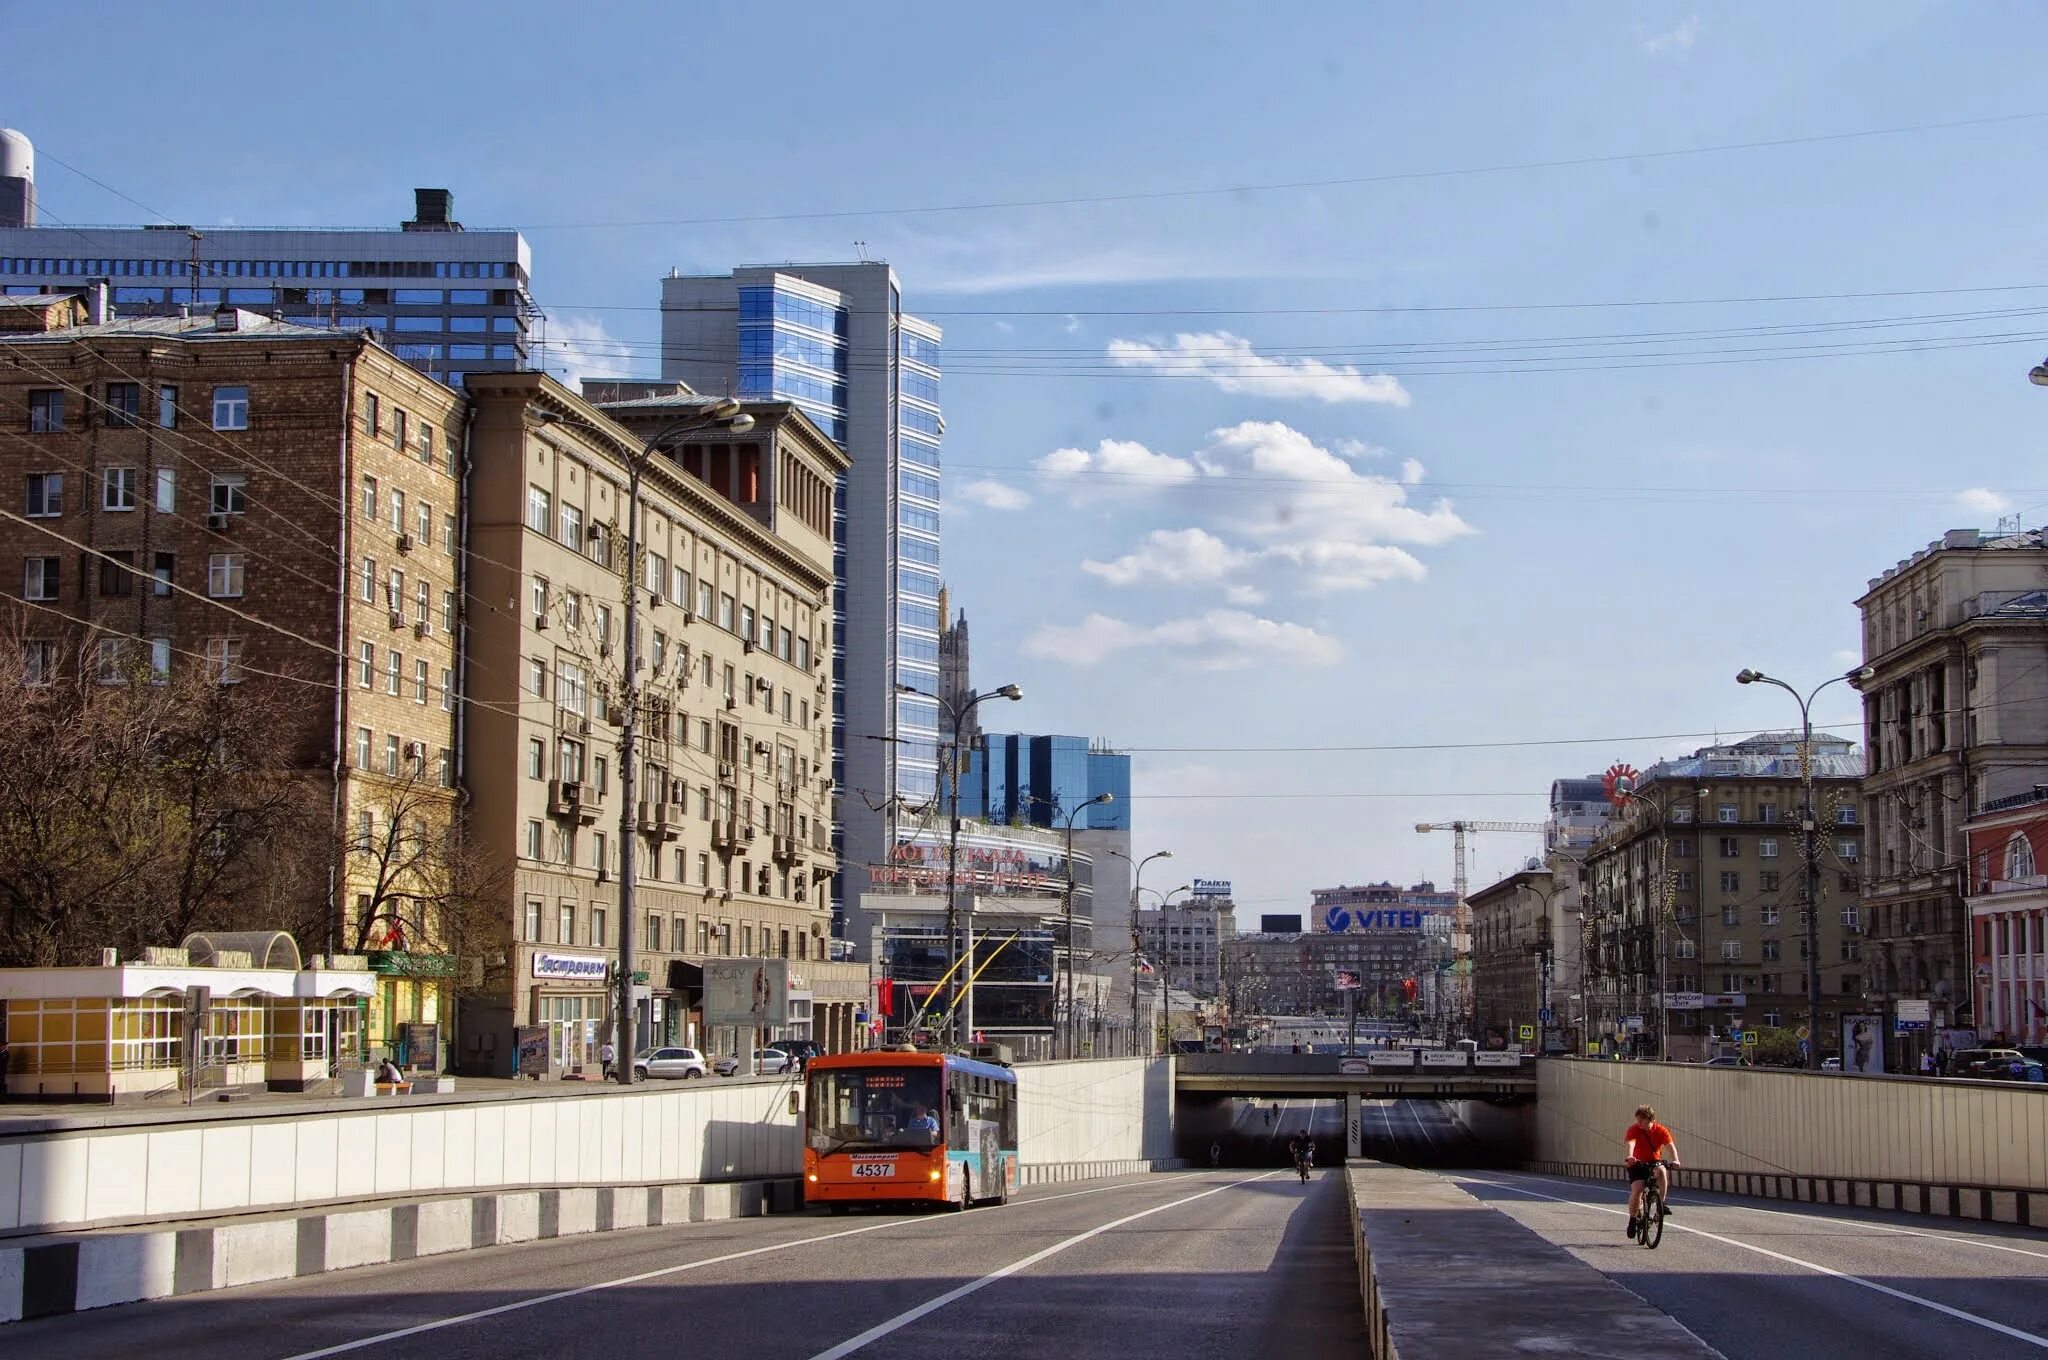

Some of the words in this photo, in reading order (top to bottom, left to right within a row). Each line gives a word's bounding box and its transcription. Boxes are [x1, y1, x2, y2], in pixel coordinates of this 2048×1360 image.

[537, 954, 605, 976] Гастроном
[1844, 1018, 1880, 1026] MANGO
[856, 1163, 890, 1177] 4537
